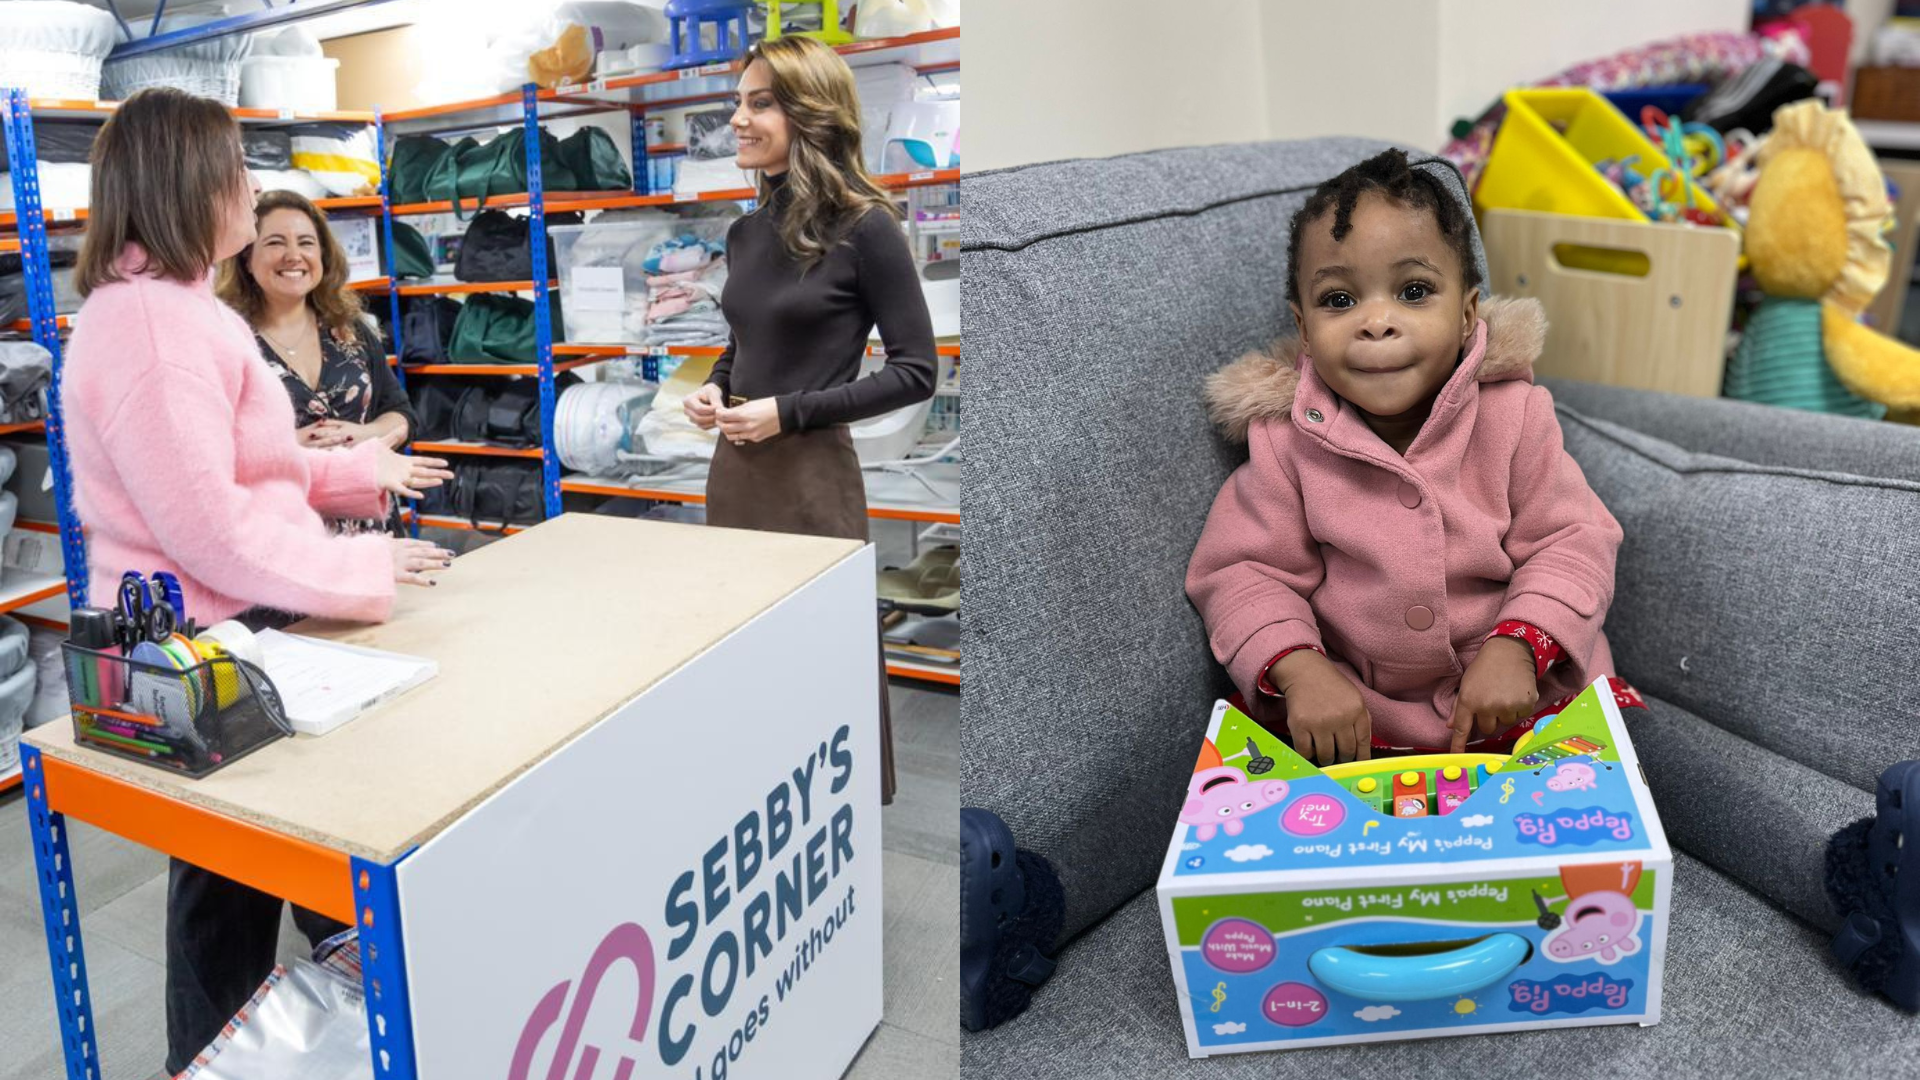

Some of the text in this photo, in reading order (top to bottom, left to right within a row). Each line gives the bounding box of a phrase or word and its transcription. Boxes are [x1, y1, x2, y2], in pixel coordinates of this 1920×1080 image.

[1298, 812, 1326, 826] Try
[1300, 804, 1330, 815] me!
[1514, 810, 1632, 844] Peppa Pig
[665, 724, 853, 961] SEBBY'S
[1294, 834, 1493, 857] Peppa's My First Piano
[1302, 884, 1508, 911] Peppa's My First Piano
[658, 803, 854, 1066] CORNER
[775, 884, 855, 1002] without
[1224, 933, 1256, 942] Peppa
[1207, 942, 1271, 951] Music With
[1226, 952, 1255, 961] Make
[1510, 977, 1626, 1011] Peppa Pig
[1270, 1000, 1321, 1012] 2-in-1
